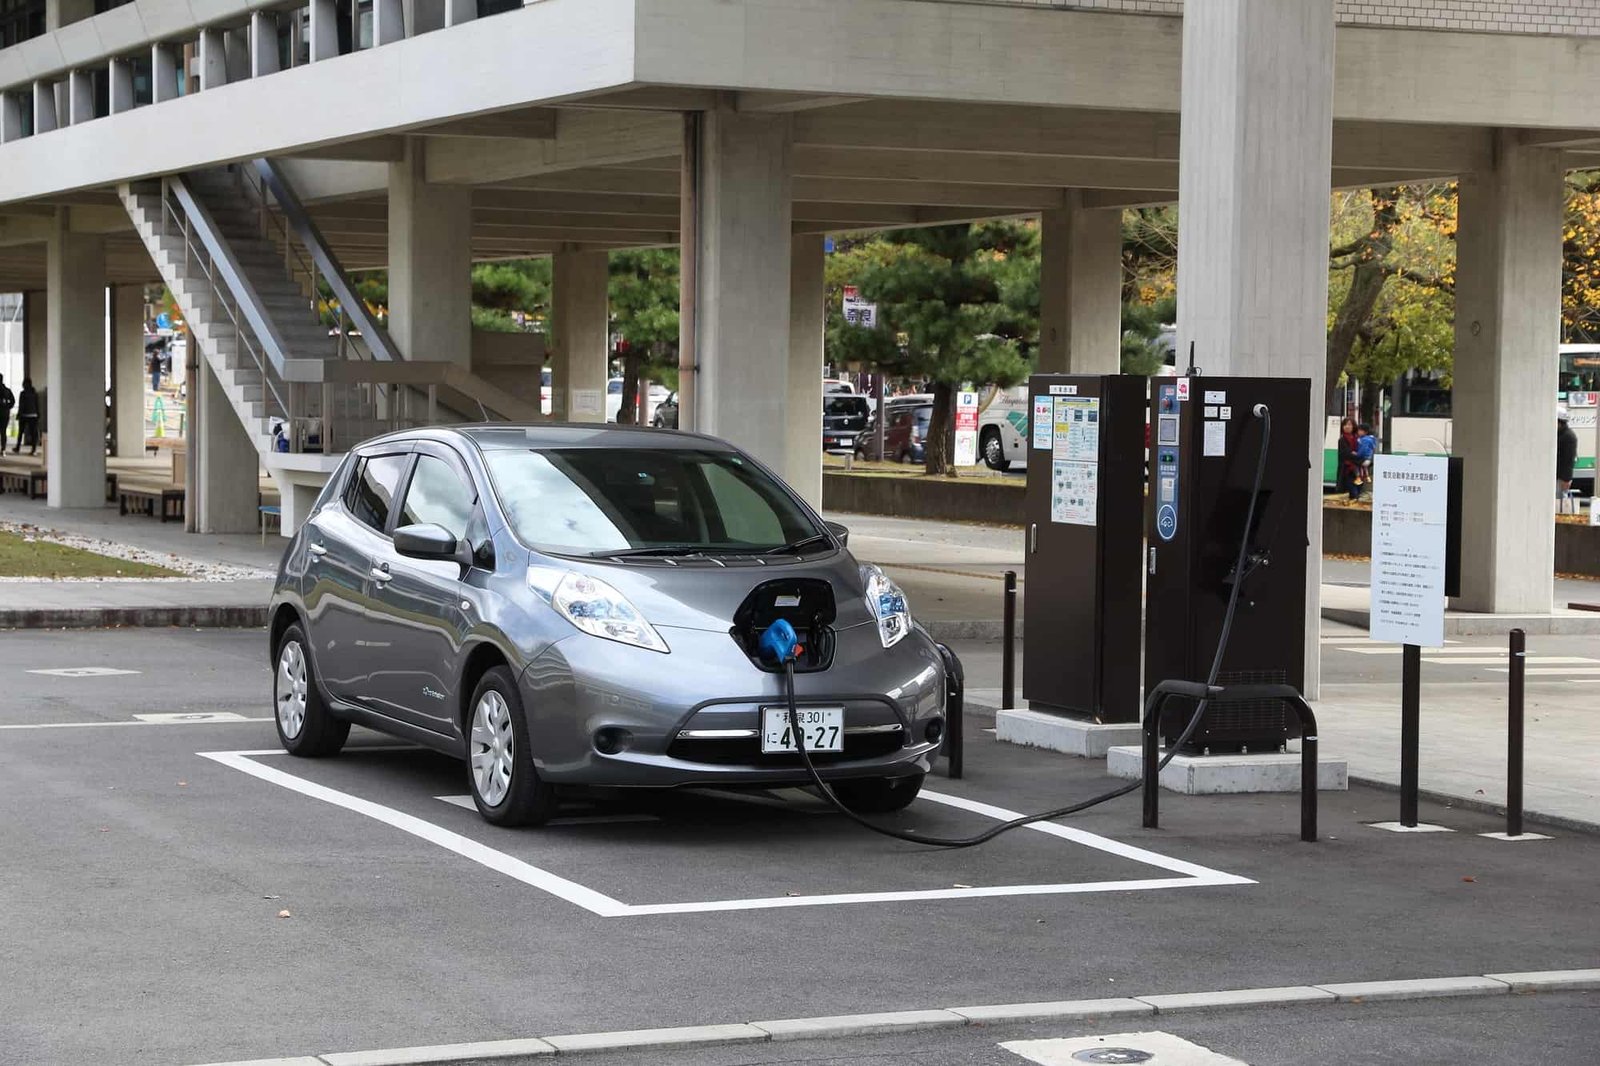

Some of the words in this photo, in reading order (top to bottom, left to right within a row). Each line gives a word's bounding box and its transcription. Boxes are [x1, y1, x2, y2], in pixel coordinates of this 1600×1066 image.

[847, 308, 871, 321] 奈良
[1567, 415, 1597, 425] イドリング
[1383, 471, 1439, 480] 電気自動車急速充電設備の
[1398, 485, 1421, 493] ご利用案内
